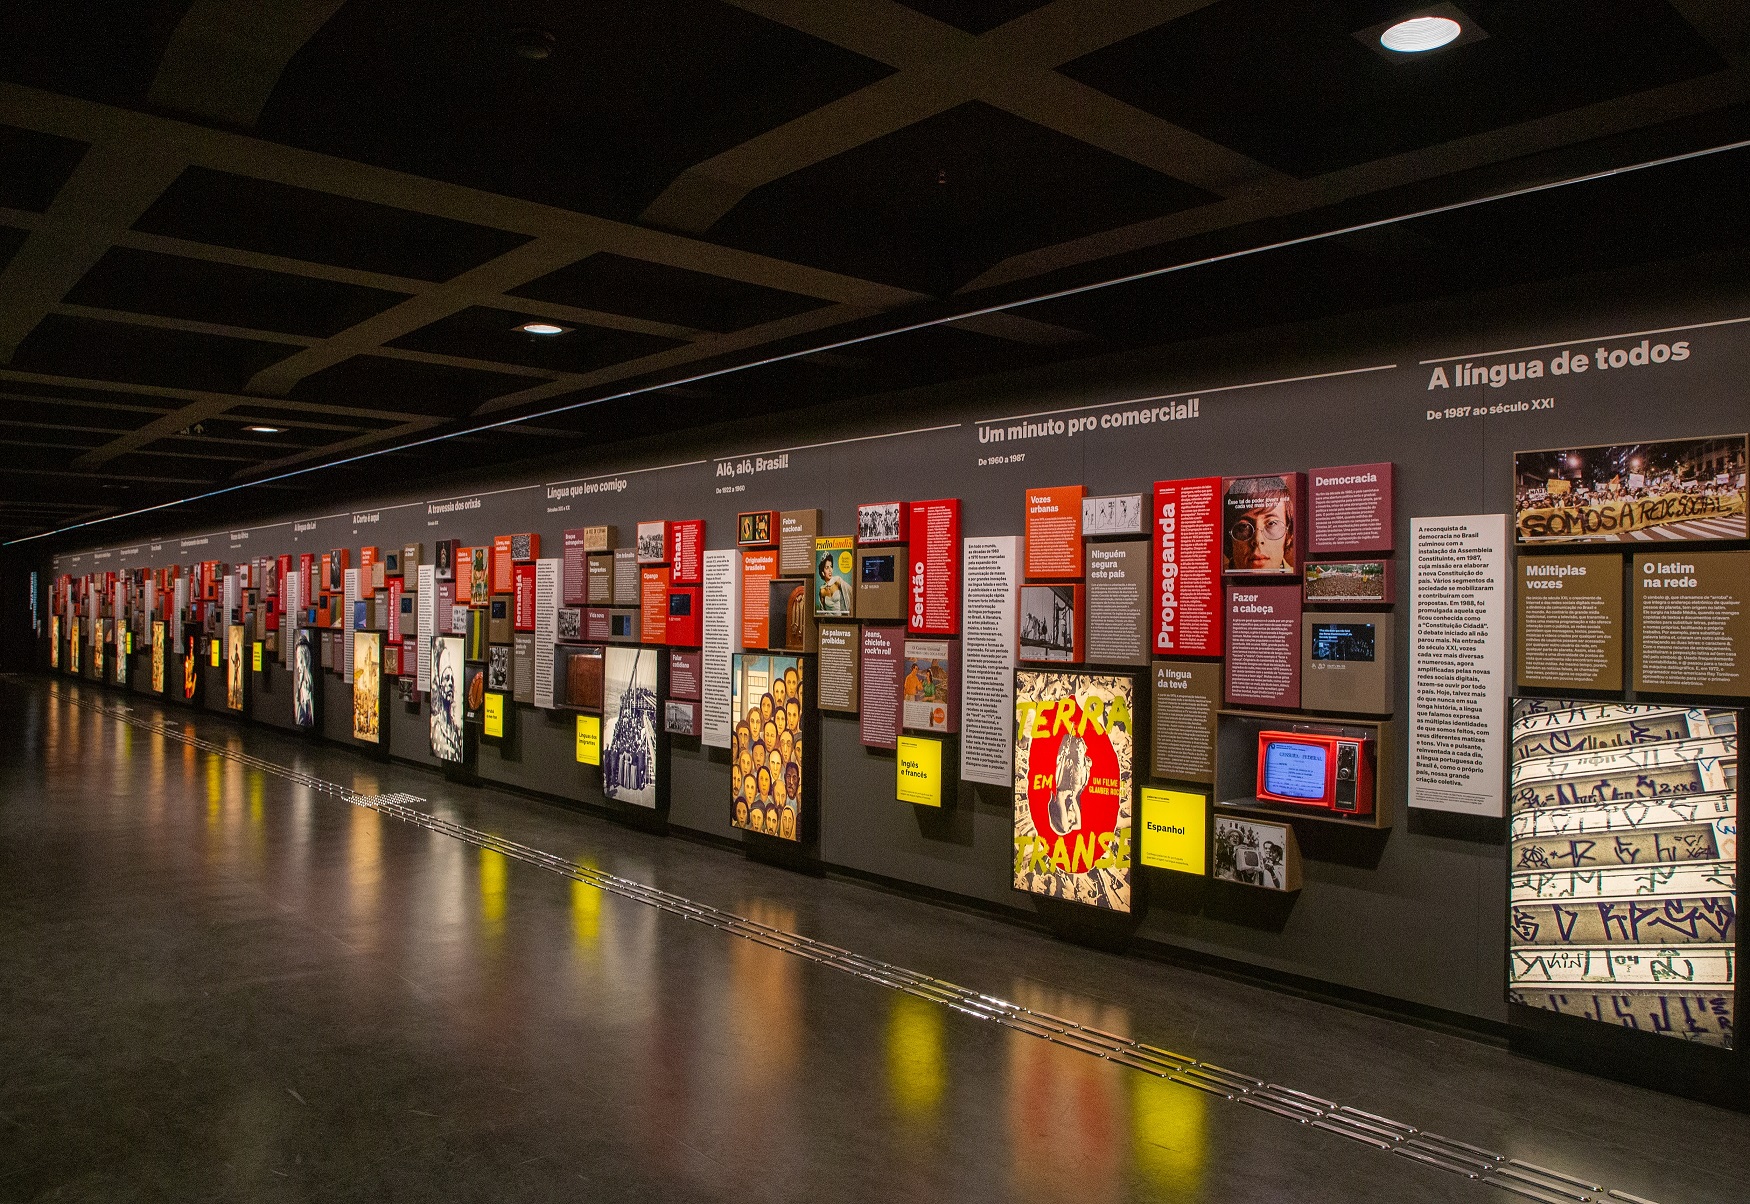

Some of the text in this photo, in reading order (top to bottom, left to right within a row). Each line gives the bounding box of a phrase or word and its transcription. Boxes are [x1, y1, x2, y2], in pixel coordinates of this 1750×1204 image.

[1427, 341, 1690, 390] A língua de todos
[1426, 398, 1554, 420] De 1987 ao século XXI
[978, 398, 1200, 444] Um minuto pro comercial!
[716, 454, 789, 477] Alô, alô, Brasil!
[978, 458, 987, 466] De
[988, 456, 1003, 465] 1960
[1009, 454, 1025, 462] 1987
[1316, 473, 1377, 487] Democracia
[547, 478, 627, 500] Língua que levo comigo
[1030, 496, 1051, 504] Vozes
[428, 498, 481, 514] A travessia dos orixás
[1030, 505, 1059, 514] urbanas
[1521, 496, 1731, 537] SOMOS A REDE SOCIAL
[673, 532, 681, 580] Tchau
[745, 556, 774, 565] Originalidade
[1091, 550, 1126, 561] Ninguém
[1091, 561, 1118, 571] segura
[1526, 564, 1587, 577] Múltiplas
[1643, 562, 1694, 574] O latim
[1108, 570, 1125, 579] país
[1158, 502, 1178, 648] Propaganda
[1526, 579, 1563, 589] vozes
[1643, 576, 1698, 588] na rede
[912, 561, 924, 629] Sertão
[1232, 592, 1258, 602] Fazer
[1232, 604, 1274, 614] a cabeça
[829, 629, 851, 638] palavras
[865, 630, 881, 638] Jeans,
[822, 637, 845, 646] proibidas
[865, 638, 886, 647] chiclete
[882, 647, 891, 655] roll
[1157, 669, 1192, 679] A língua
[1157, 679, 1188, 689] da tevê
[1016, 696, 1132, 741] TERRA
[901, 759, 919, 770] Inglês
[906, 769, 927, 779] francês
[1033, 774, 1053, 790] EM
[1092, 777, 1101, 785] UM
[1102, 777, 1118, 787] FILME
[1089, 786, 1110, 795] GLAUBER
[1147, 821, 1185, 835] Espanhol
[1014, 828, 1131, 874] TRANSE
